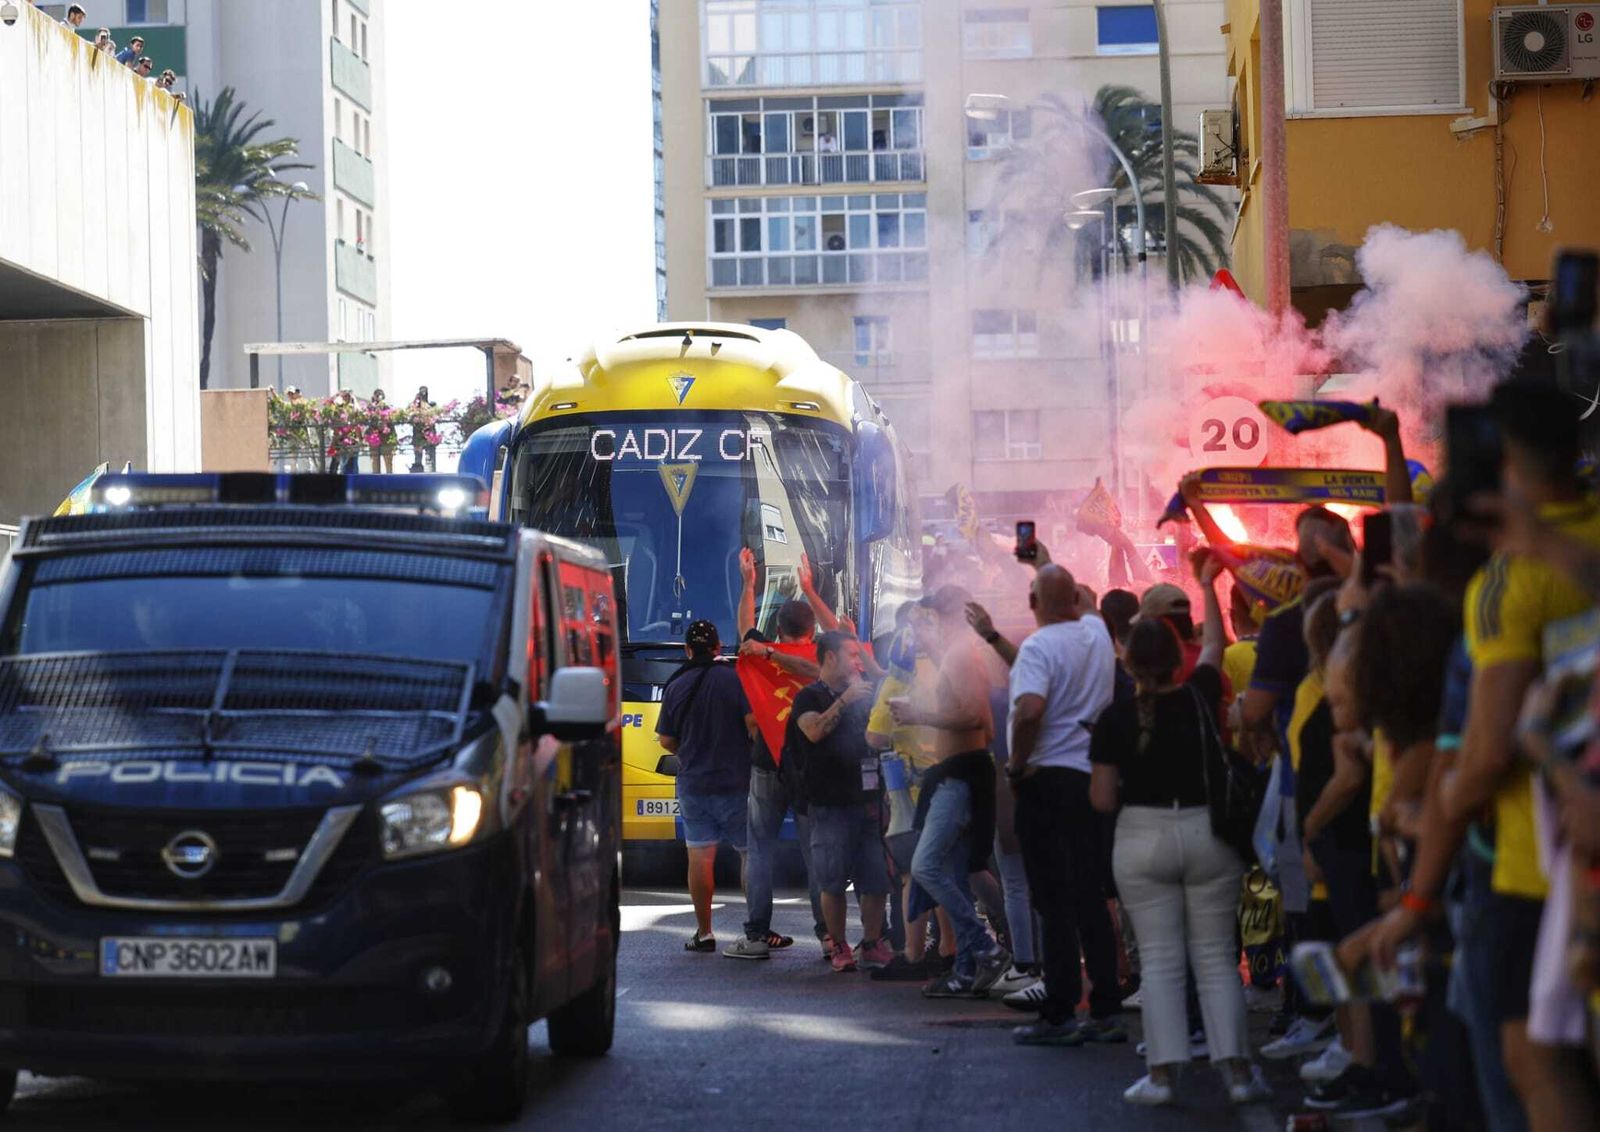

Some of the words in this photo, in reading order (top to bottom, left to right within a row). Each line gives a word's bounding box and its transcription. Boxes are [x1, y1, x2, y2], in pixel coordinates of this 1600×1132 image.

[1578, 34, 1593, 43] LG
[591, 429, 703, 461] CADIZ
[719, 429, 772, 461] CF
[1201, 416, 1260, 452] 20
[647, 801, 680, 814] 8912
